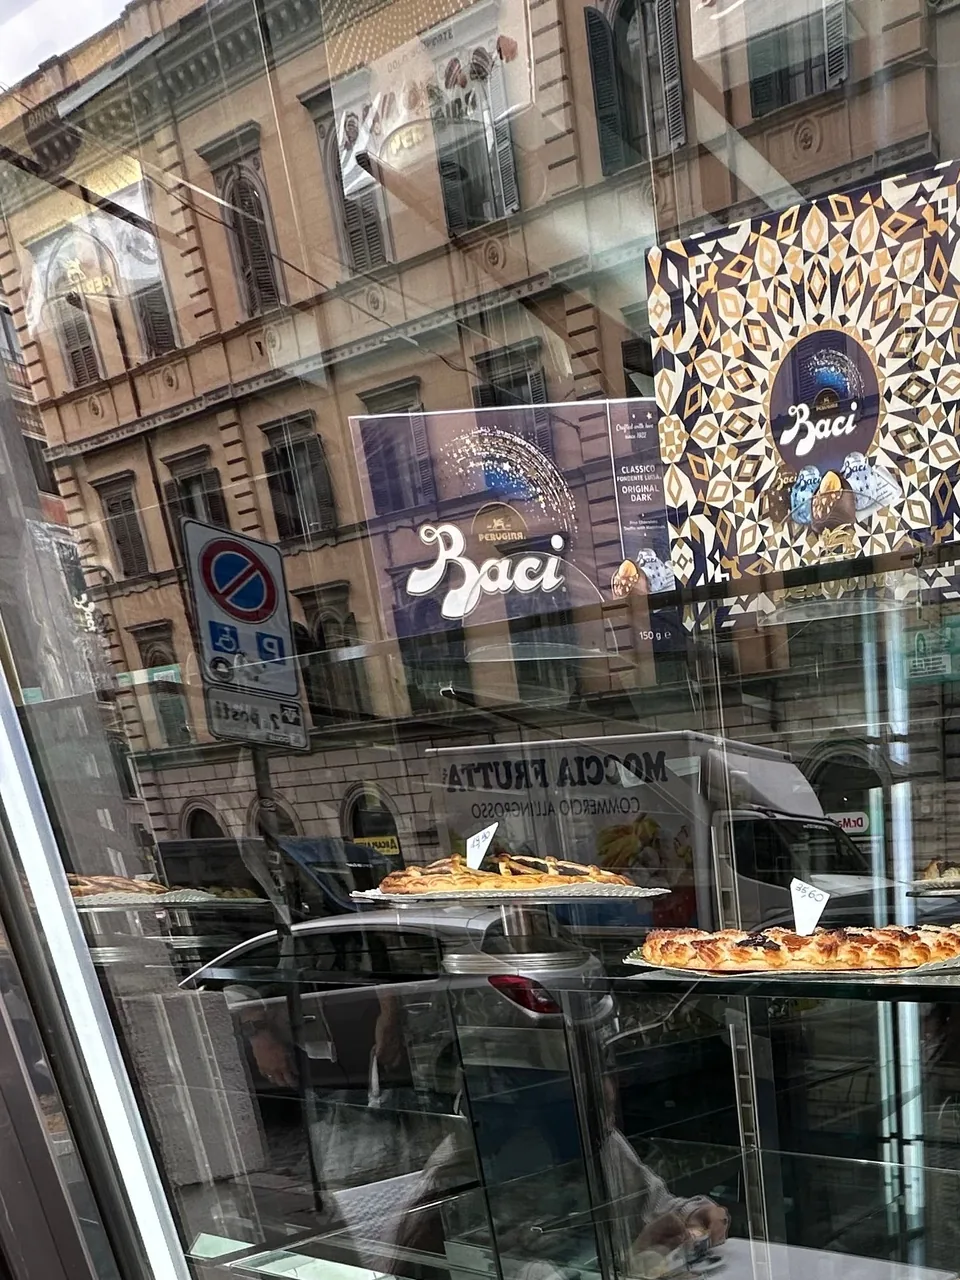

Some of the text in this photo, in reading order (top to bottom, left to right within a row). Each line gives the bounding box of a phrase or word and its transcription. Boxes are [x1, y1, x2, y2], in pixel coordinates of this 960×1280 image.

[779, 401, 859, 457] Baci
[621, 464, 656, 474] CLASSICO
[843, 460, 868, 479] Baci
[616, 474, 644, 483] FONDENTE
[775, 471, 798, 490] Baci
[797, 474, 822, 491] Baci
[621, 484, 660, 494] ORIGINAL
[630, 493, 653, 502] DARK
[477, 531, 526, 543] PERUGINA
[405, 522, 565, 621] Baci
[639, 630, 654, 640] 150
[655, 632, 662, 641] g
[795, 883, 825, 903] 35,60
